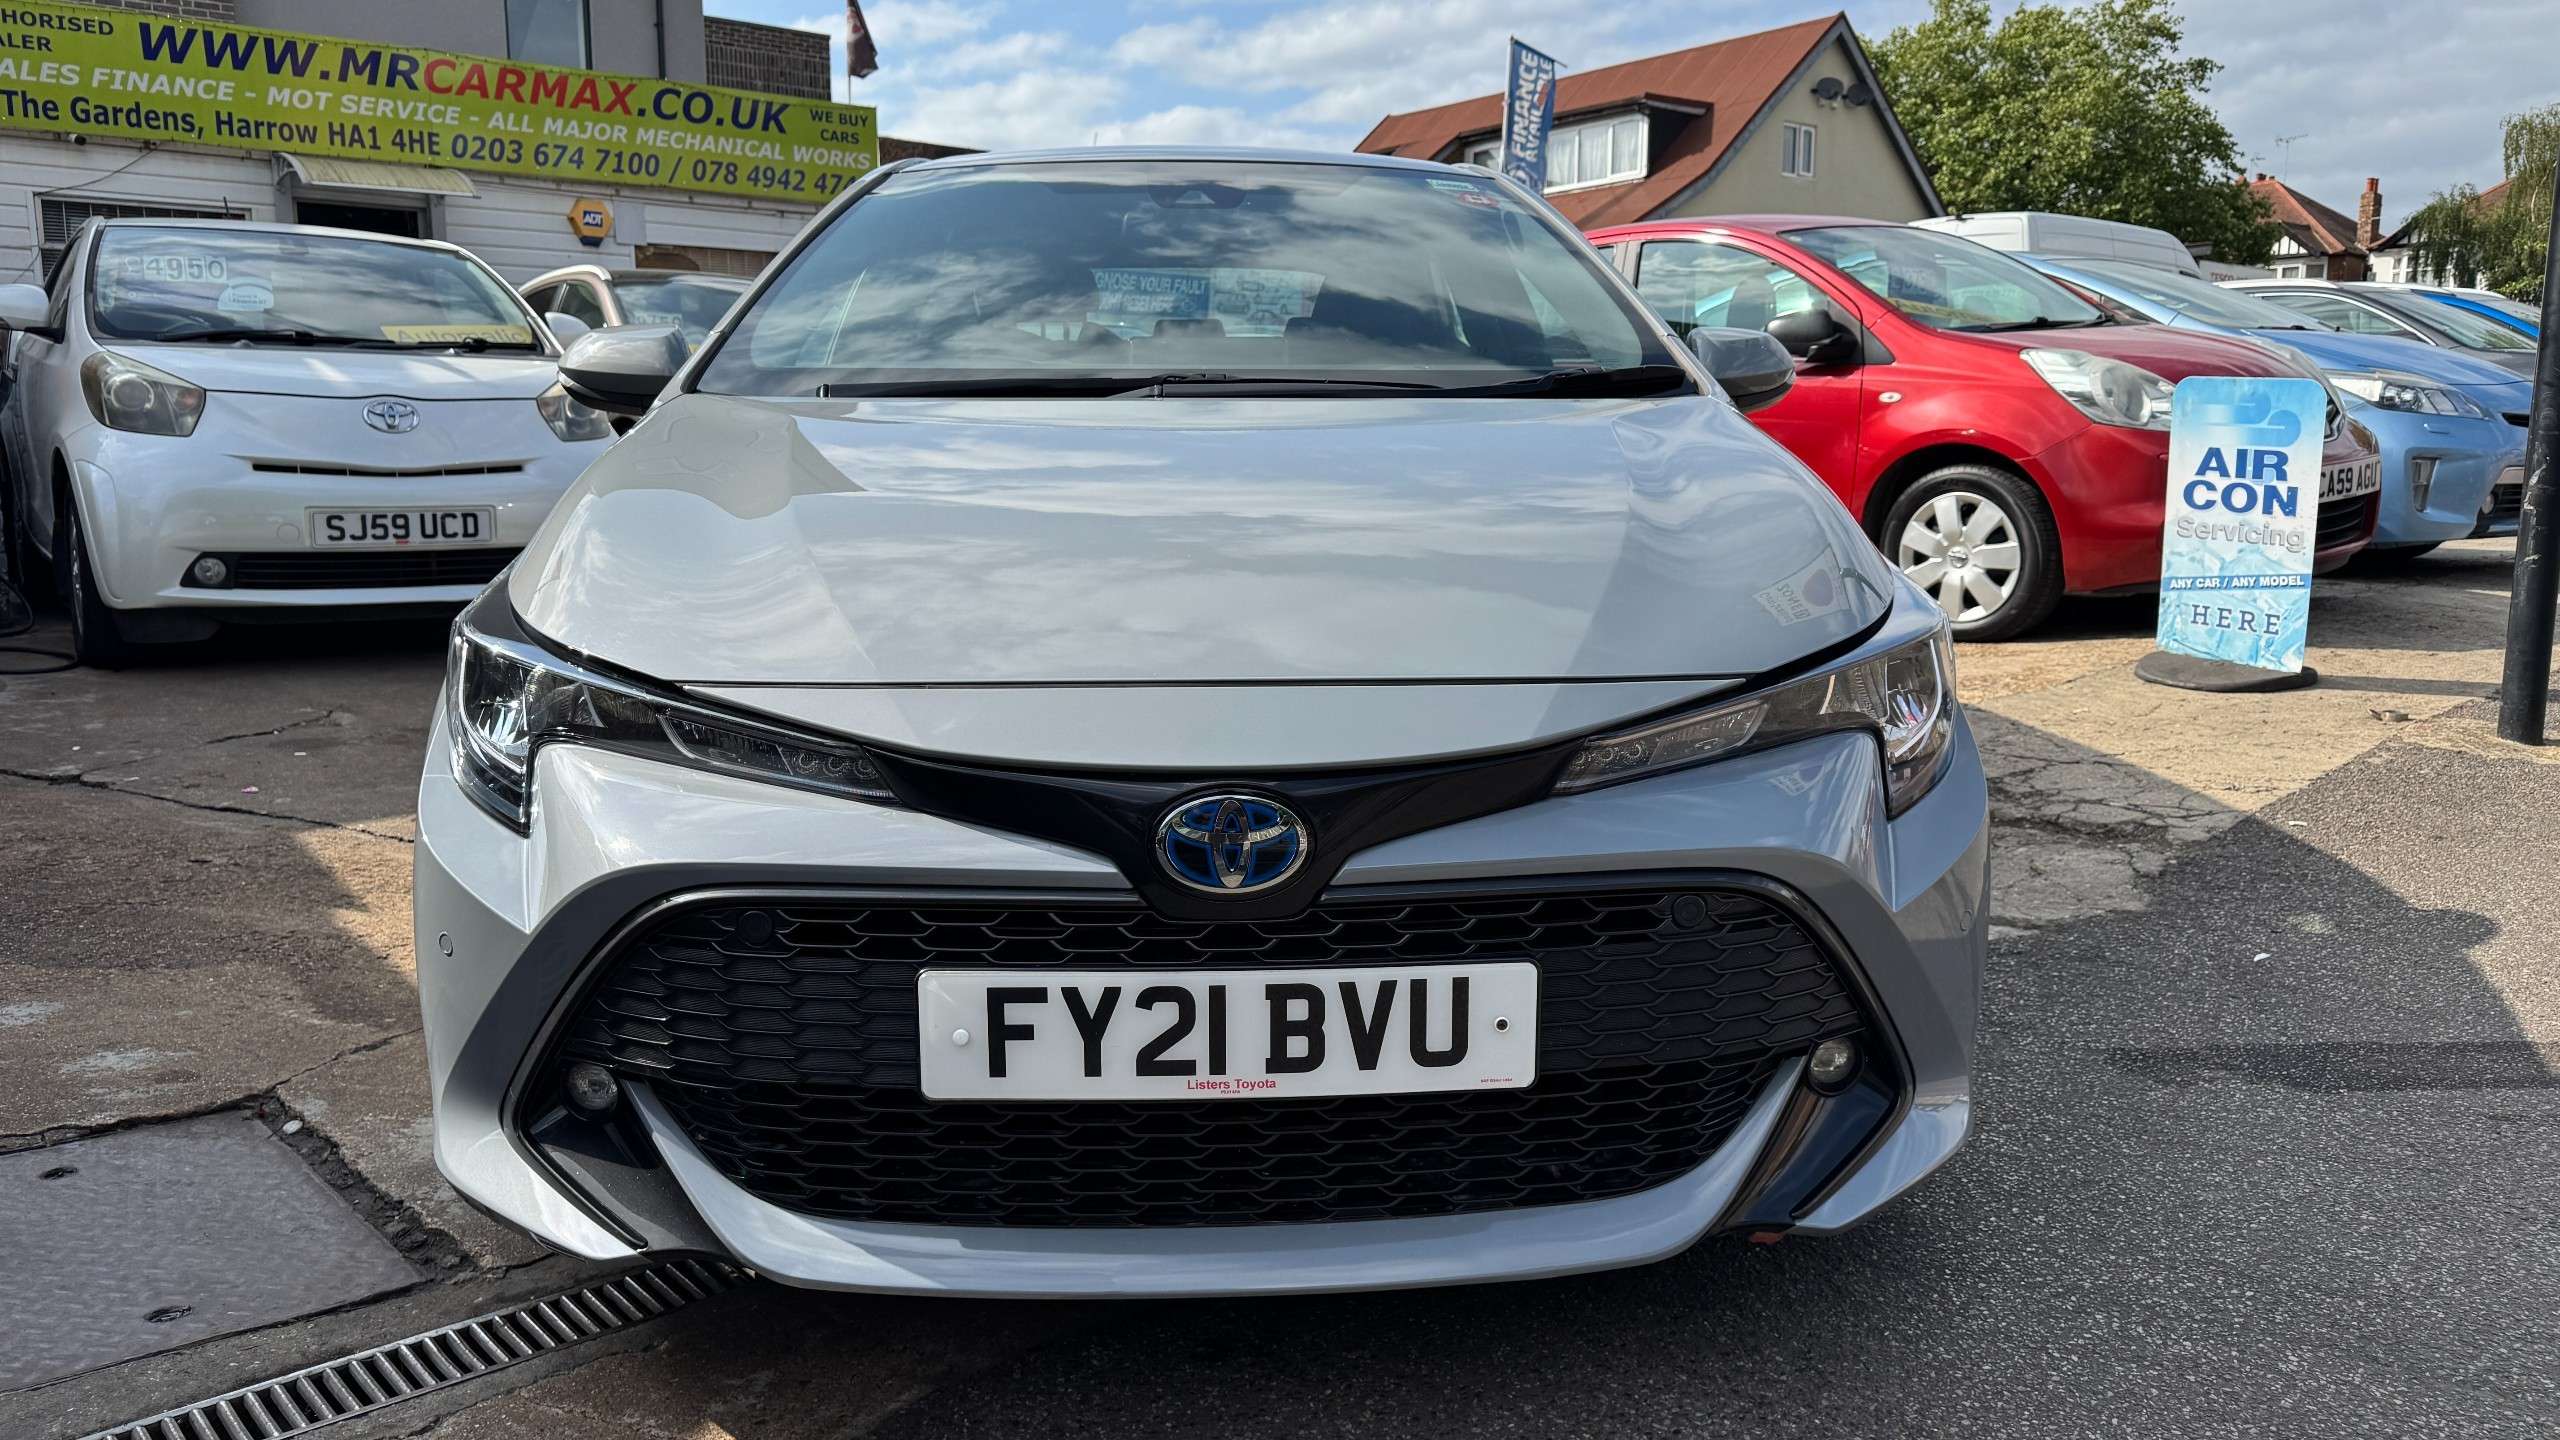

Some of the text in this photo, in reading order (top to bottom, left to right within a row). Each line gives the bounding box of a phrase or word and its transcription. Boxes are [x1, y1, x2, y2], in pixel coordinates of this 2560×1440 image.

[139, 22, 792, 135] WWW.MRCARMAX.CO.UK
[91, 67, 235, 101] FINANCE
[266, 86, 332, 111] MOT
[341, 94, 460, 125] SERVICE
[488, 112, 534, 134] ALL
[543, 115, 628, 143] MAJOR
[636, 128, 786, 161] MECHANICAL
[793, 145, 871, 169] WORKS
[810, 109, 868, 127] WE BUY
[1511, 49, 1539, 159] FINANCE
[0, 88, 59, 121] The
[70, 96, 204, 140] Gardens,
[215, 110, 318, 145] Harrow
[328, 121, 382, 150] HA1
[392, 126, 441, 156] 4HE
[451, 134, 523, 164] 0203
[534, 142, 584, 169] 674
[595, 148, 661, 177] 7100
[691, 160, 738, 186] 078
[747, 165, 805, 193] 4942
[820, 128, 859, 144] CARS
[584, 213, 602, 225] ADT
[1140, 276, 1172, 292] YOUR
[1173, 278, 1207, 295] FAULT
[2195, 447, 2289, 482] AIR
[2356, 461, 2377, 491] AGU
[2183, 479, 2299, 517] CON
[326, 512, 479, 541] SJ59 UCD
[2176, 516, 2306, 553] Servicing
[2170, 579, 2194, 589] ANY
[2196, 578, 2220, 588] CAR
[2232, 577, 2256, 588] ANY
[2259, 576, 2304, 588] MODEL
[2190, 604, 2281, 635] HERE
[986, 976, 1470, 1079] FY21 BVU
[1187, 1078, 1277, 1092] Listers Toyota
